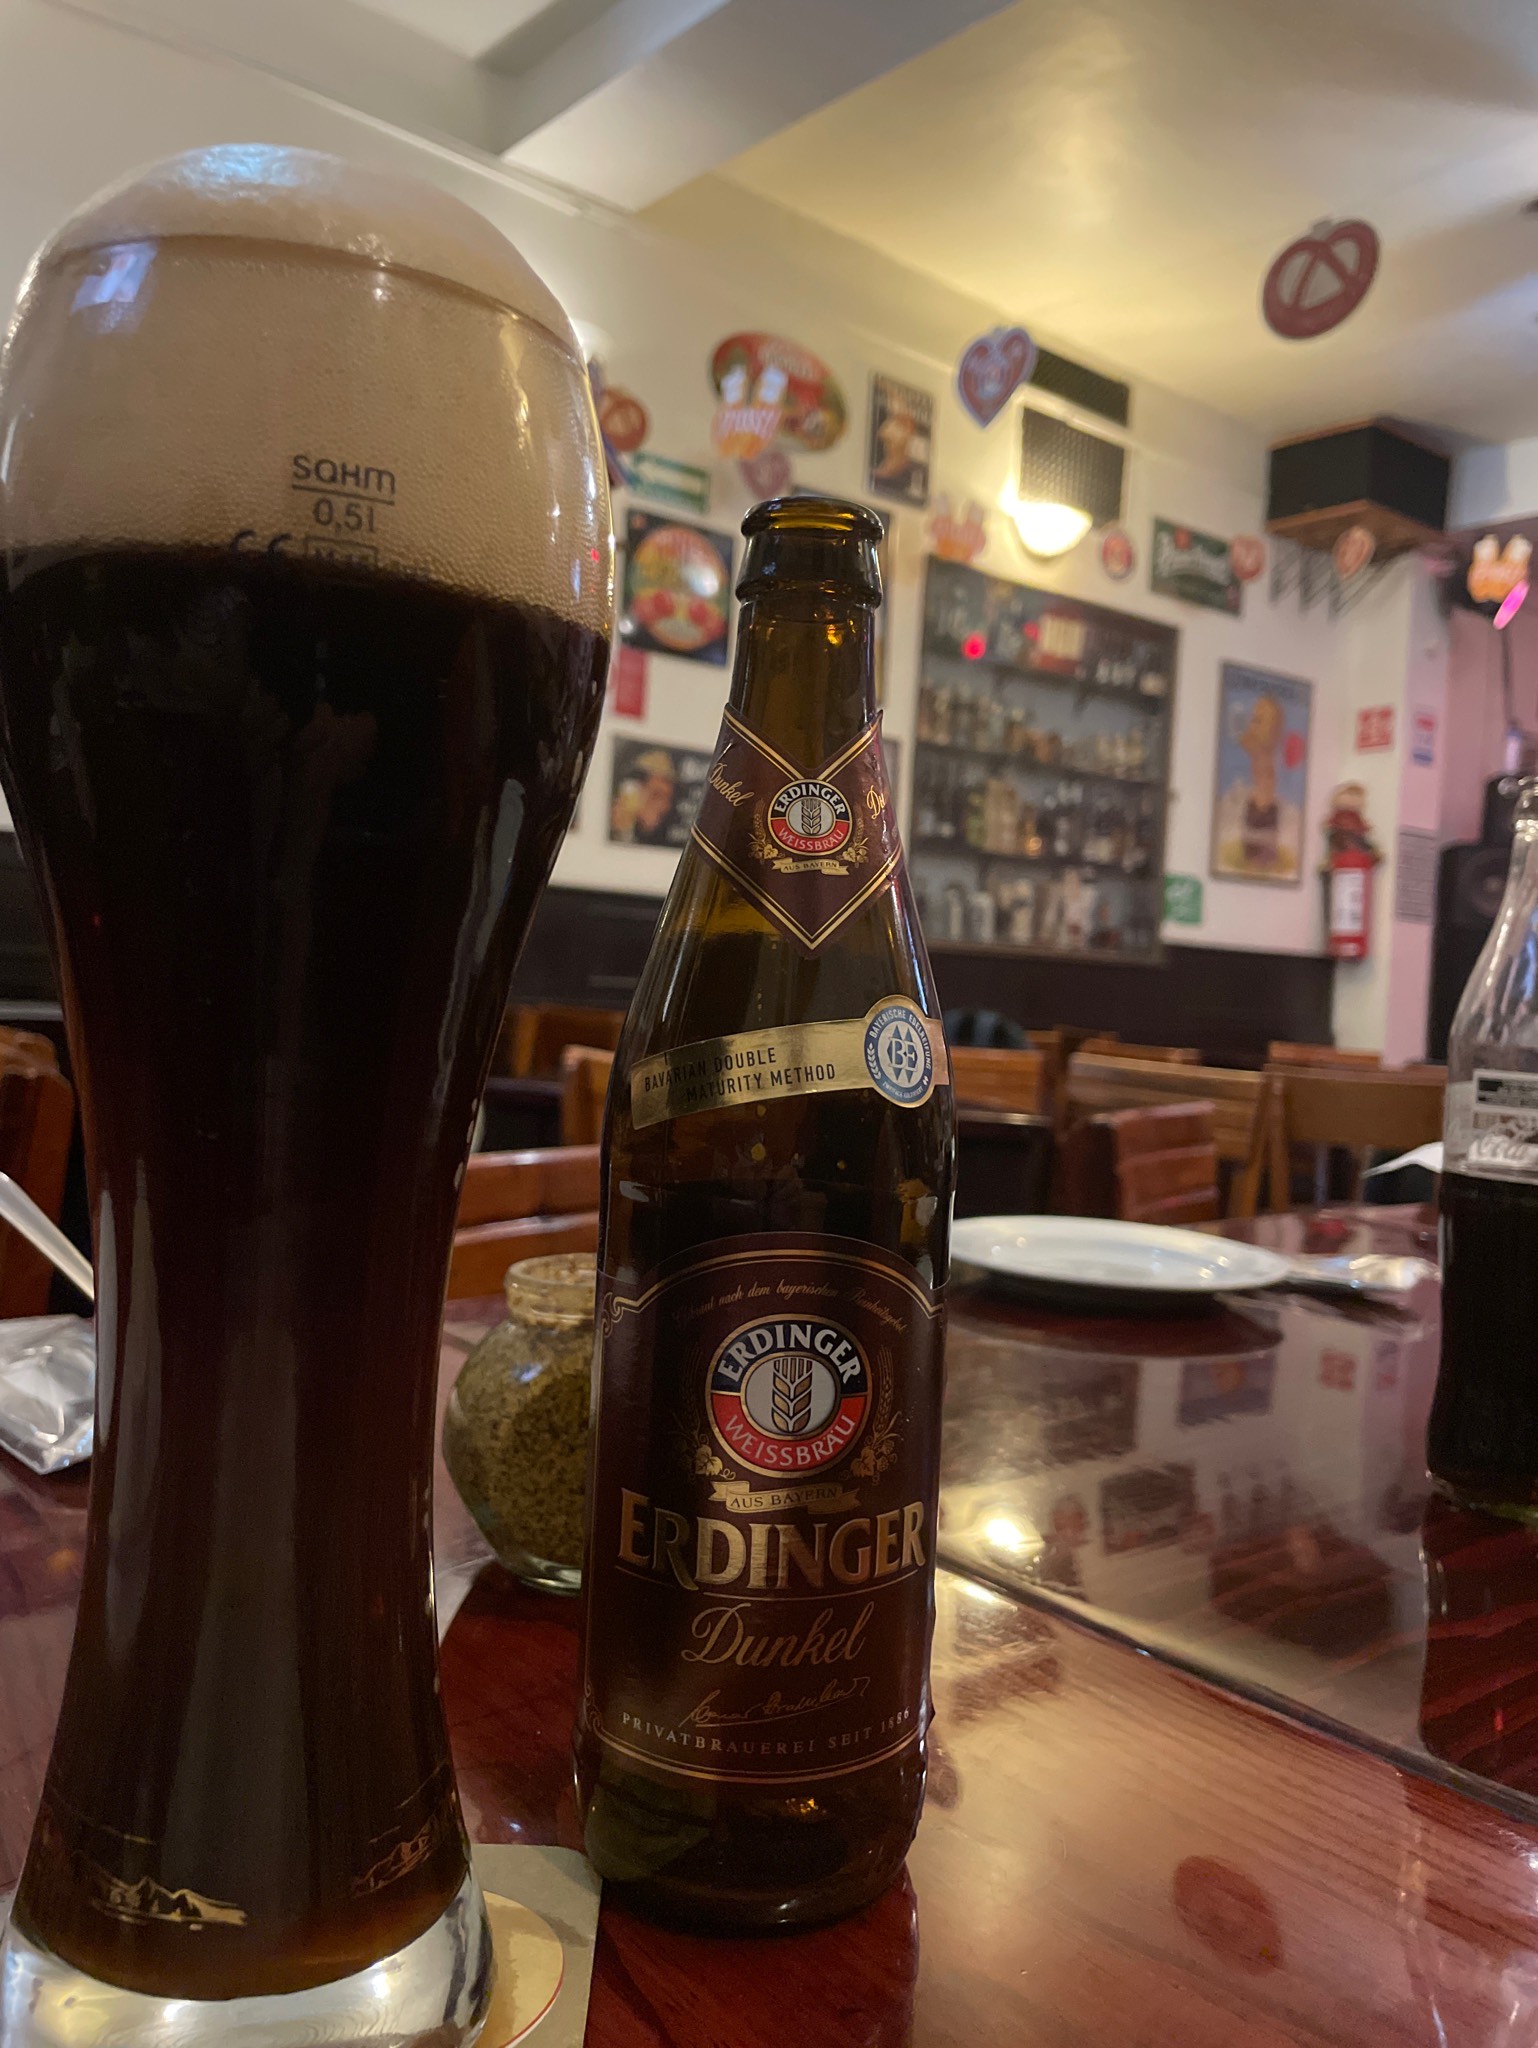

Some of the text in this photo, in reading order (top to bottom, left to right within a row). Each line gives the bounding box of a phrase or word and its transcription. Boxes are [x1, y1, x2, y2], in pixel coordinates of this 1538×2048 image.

[708, 762, 755, 808] Dunkel
[774, 783, 846, 815] ERDINGER
[783, 860, 838, 872] AUS BAYERN
[644, 1047, 777, 1093] BAVARIAN DOUBLE
[686, 1063, 837, 1103] MATURITY METHOD
[747, 1280, 770, 1299] dem
[718, 1323, 862, 1385] ERDINGER
[725, 1413, 856, 1467] WEISSBRÄU
[730, 1486, 839, 1509] AUS BAYERN
[618, 1487, 926, 1591] ERDINGER
[681, 1600, 875, 1668] Dunkel
[622, 1711, 815, 1755] PRIVATBRAUEREI
[827, 1728, 872, 1750] SEIT
